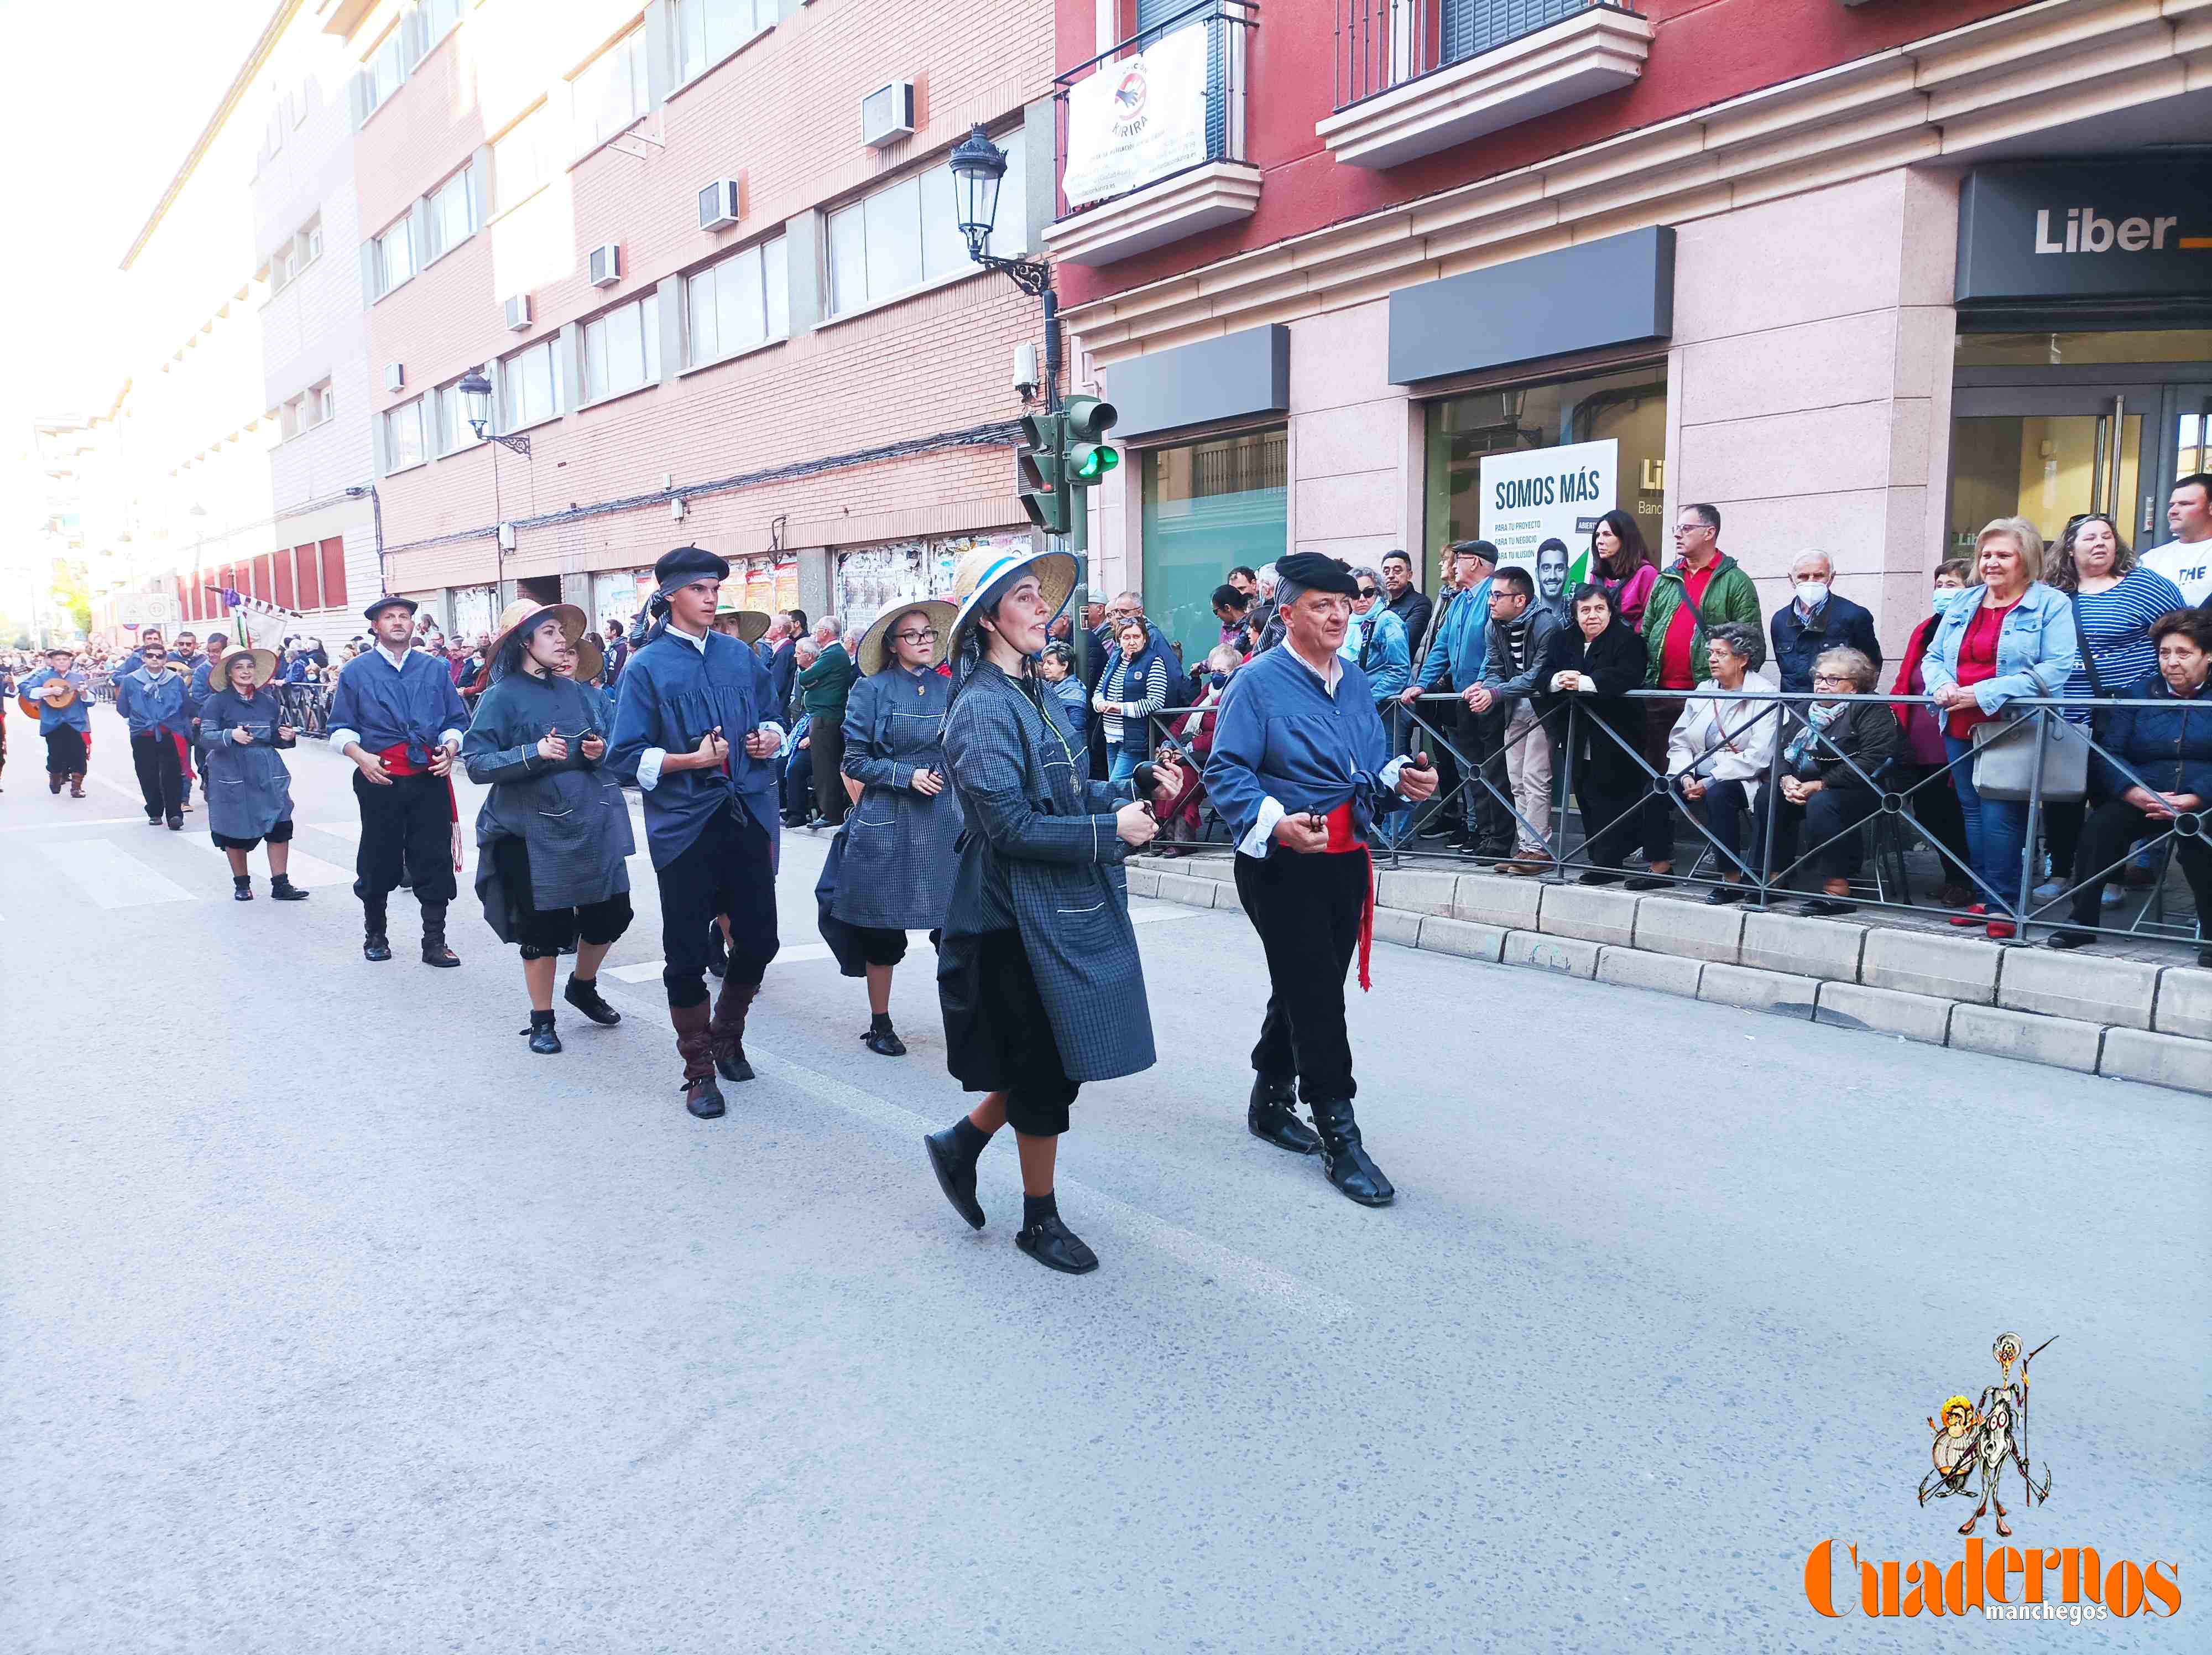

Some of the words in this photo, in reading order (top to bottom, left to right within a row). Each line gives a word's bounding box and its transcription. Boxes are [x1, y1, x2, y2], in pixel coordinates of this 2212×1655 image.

[2035, 207, 2177, 254] Liber
[1496, 476, 1554, 509] SOMOS
[1560, 466, 1599, 503] MÁS
[1639, 501, 1663, 514] Banc
[1495, 523, 1507, 532] PARA
[1516, 520, 1541, 530] PROYECTO
[1578, 521, 1598, 529] ABIERT
[1516, 535, 1537, 544] NEGOCIO
[1498, 551, 1507, 560] ARA
[2179, 566, 2206, 581] THE
